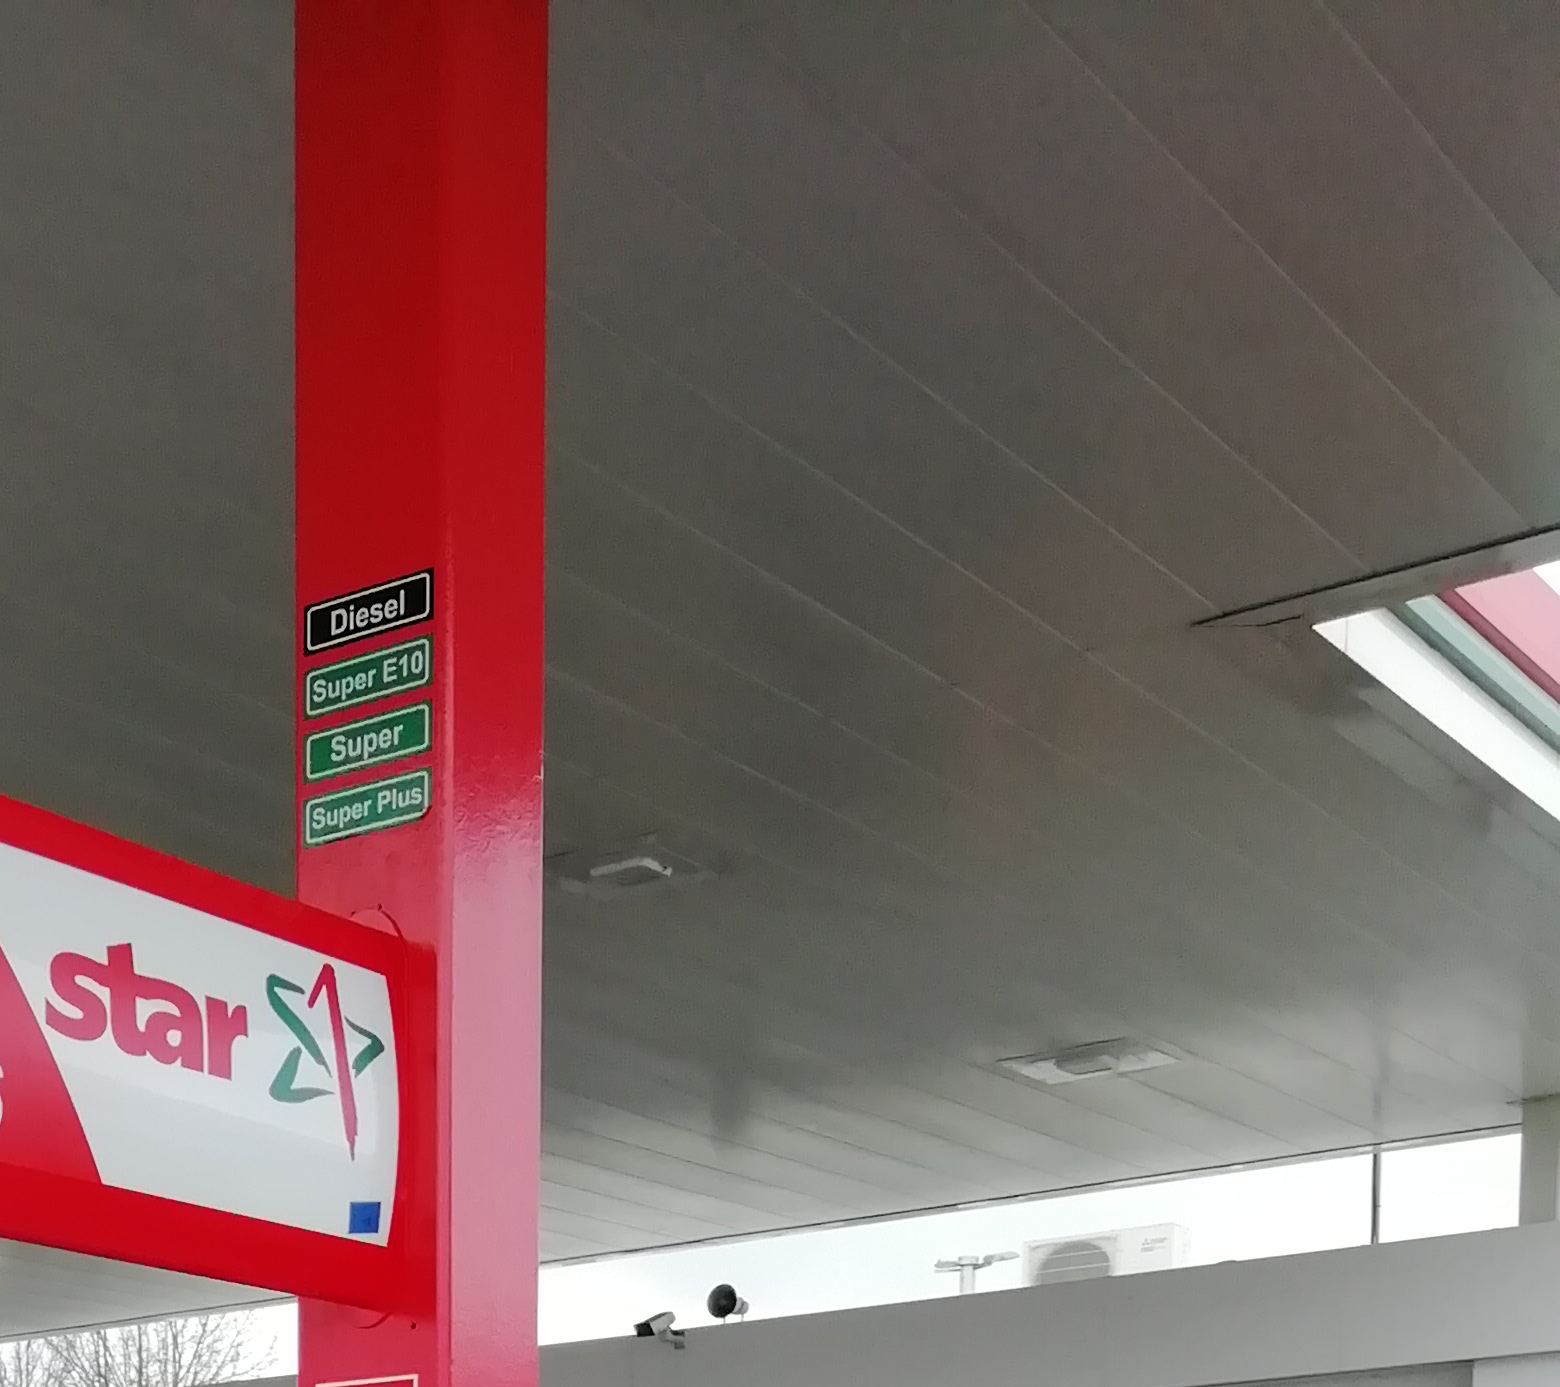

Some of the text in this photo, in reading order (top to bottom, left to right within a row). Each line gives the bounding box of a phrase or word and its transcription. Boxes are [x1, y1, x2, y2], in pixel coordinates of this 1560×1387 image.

[330, 589, 405, 636] Diesel
[312, 651, 424, 702] Super E10
[330, 724, 404, 762] Super
[311, 786, 423, 832] Super Plus
[44, 943, 249, 1080] star
